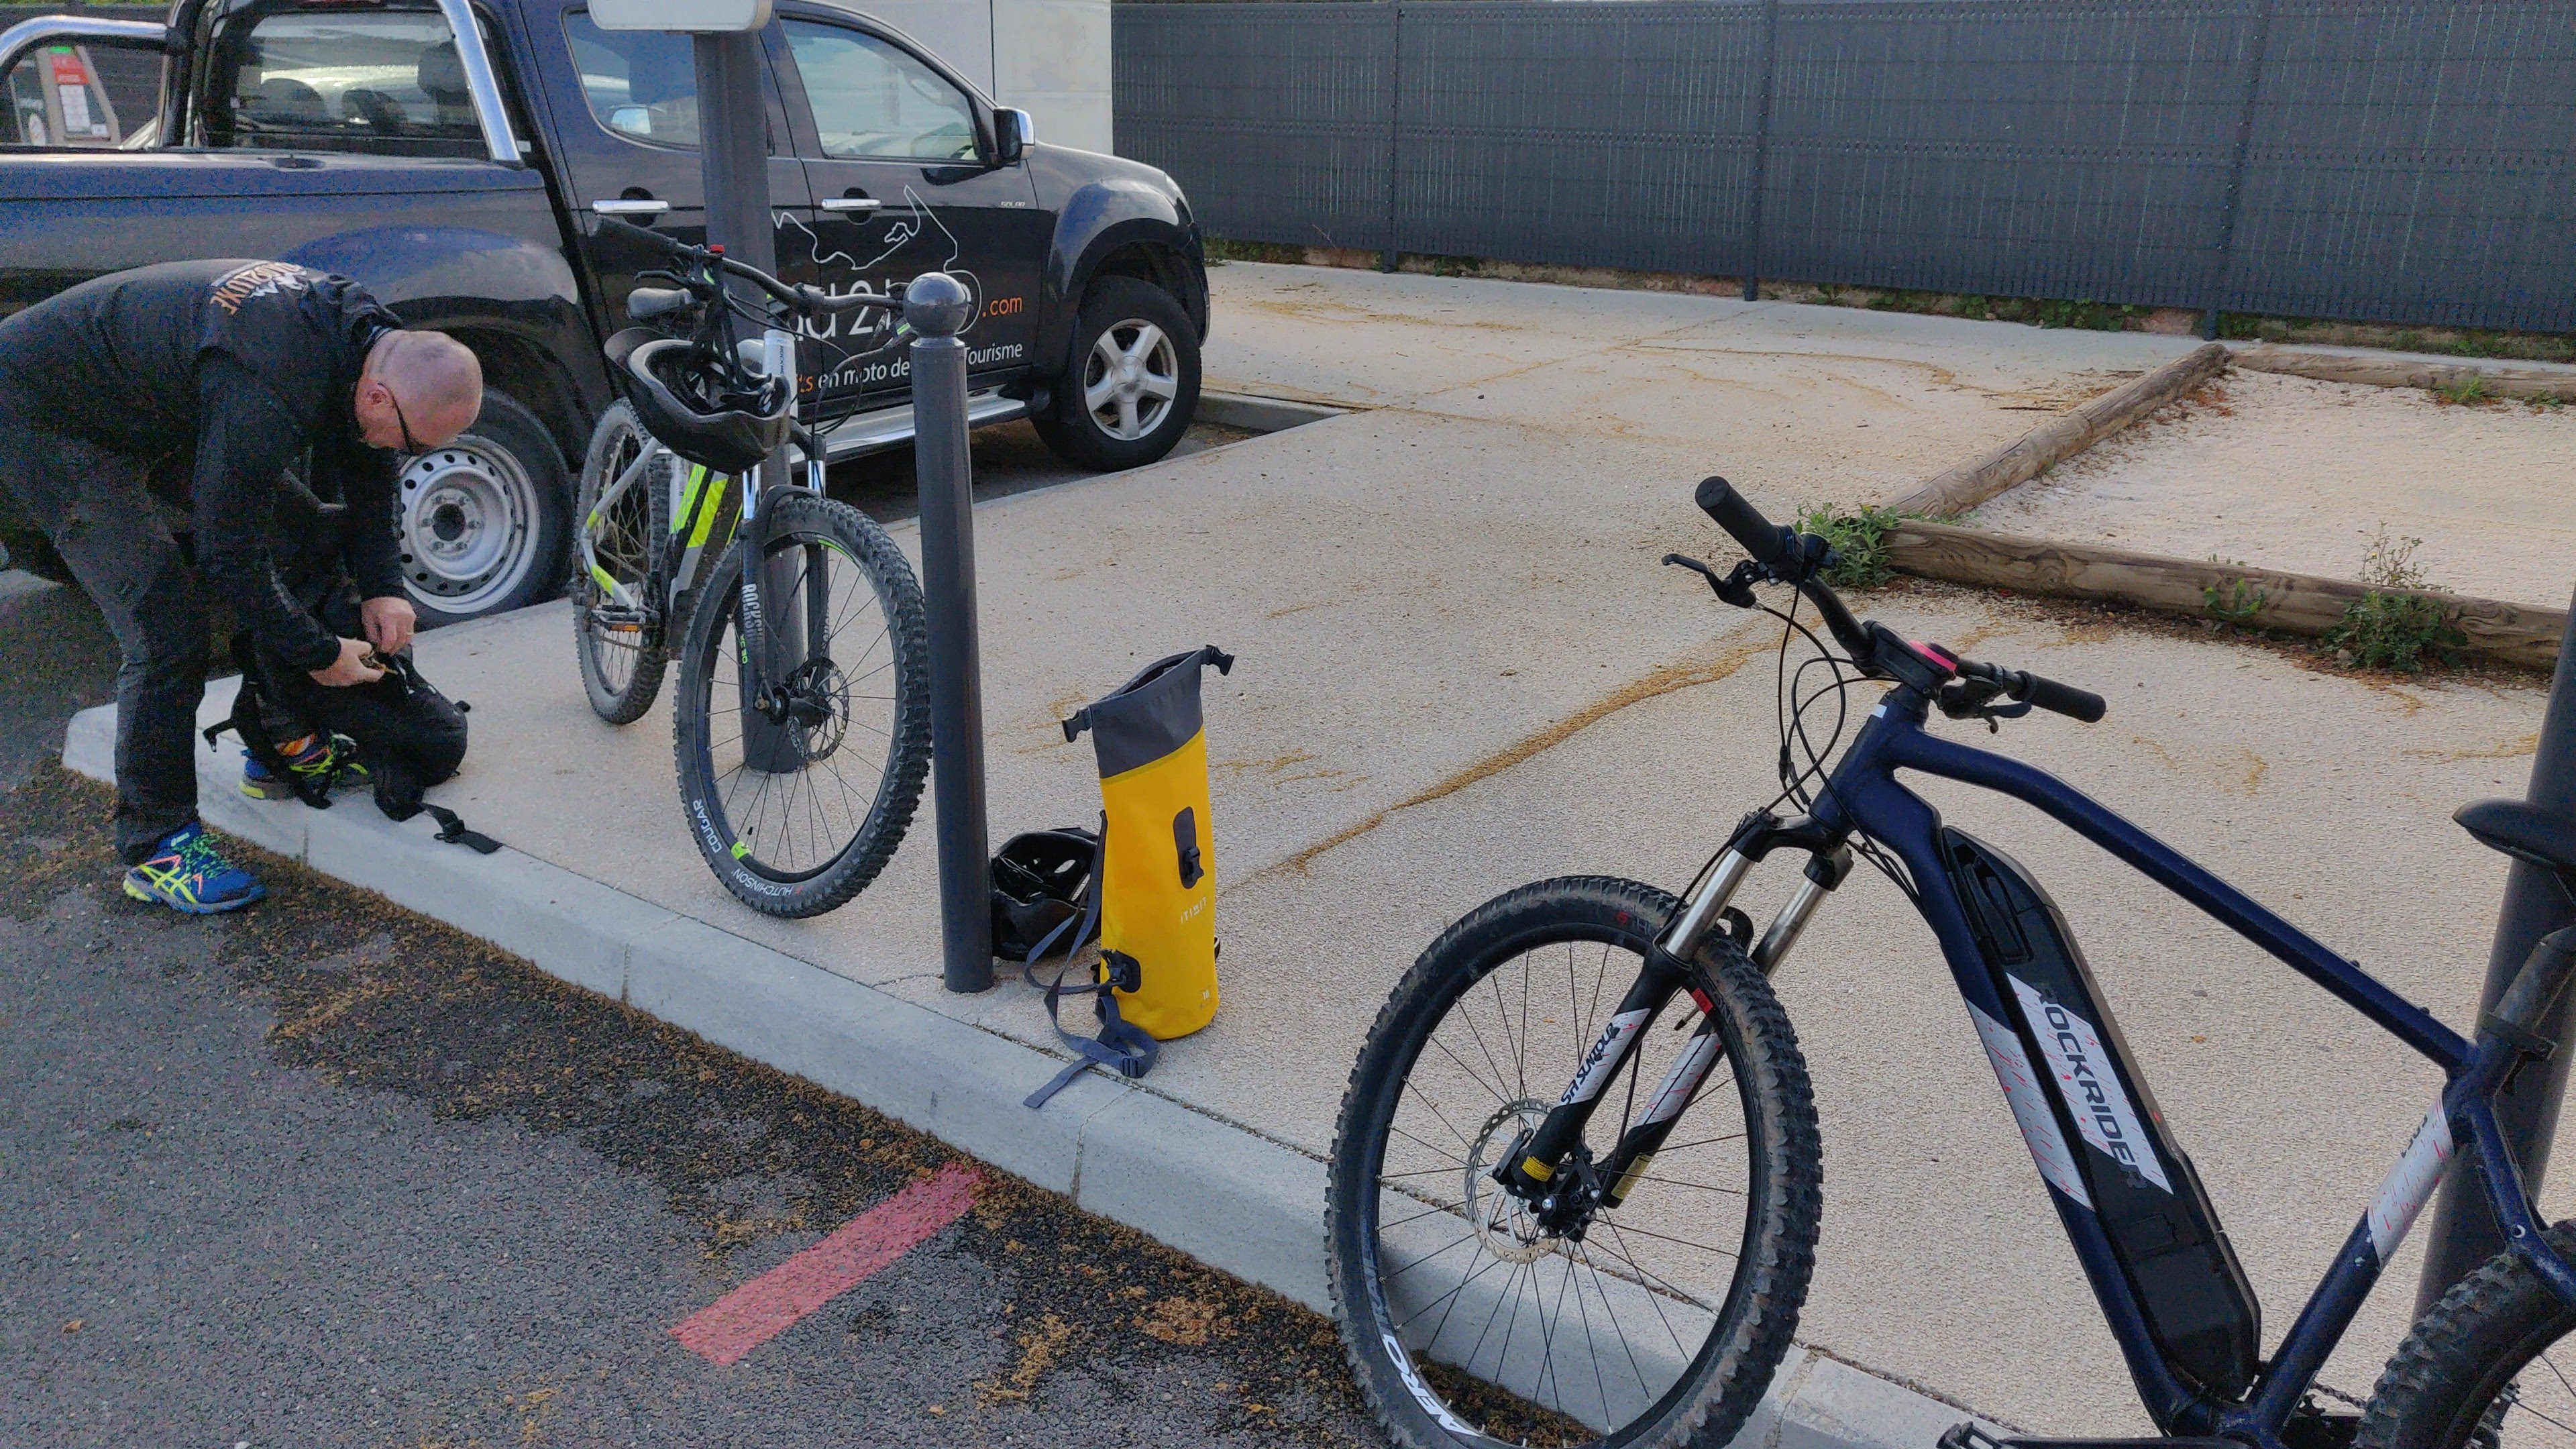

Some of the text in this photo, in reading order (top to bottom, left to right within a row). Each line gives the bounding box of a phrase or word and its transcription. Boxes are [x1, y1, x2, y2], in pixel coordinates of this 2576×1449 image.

[818, 372, 839, 388] en
[843, 362, 887, 386] moto
[890, 356, 910, 378] de
[964, 342, 1024, 366] Tourisme
[693, 799, 722, 853] COUGAR
[733, 868, 793, 896] HUTCHINSON
[1577, 1022, 1620, 1085] SUNTOUR
